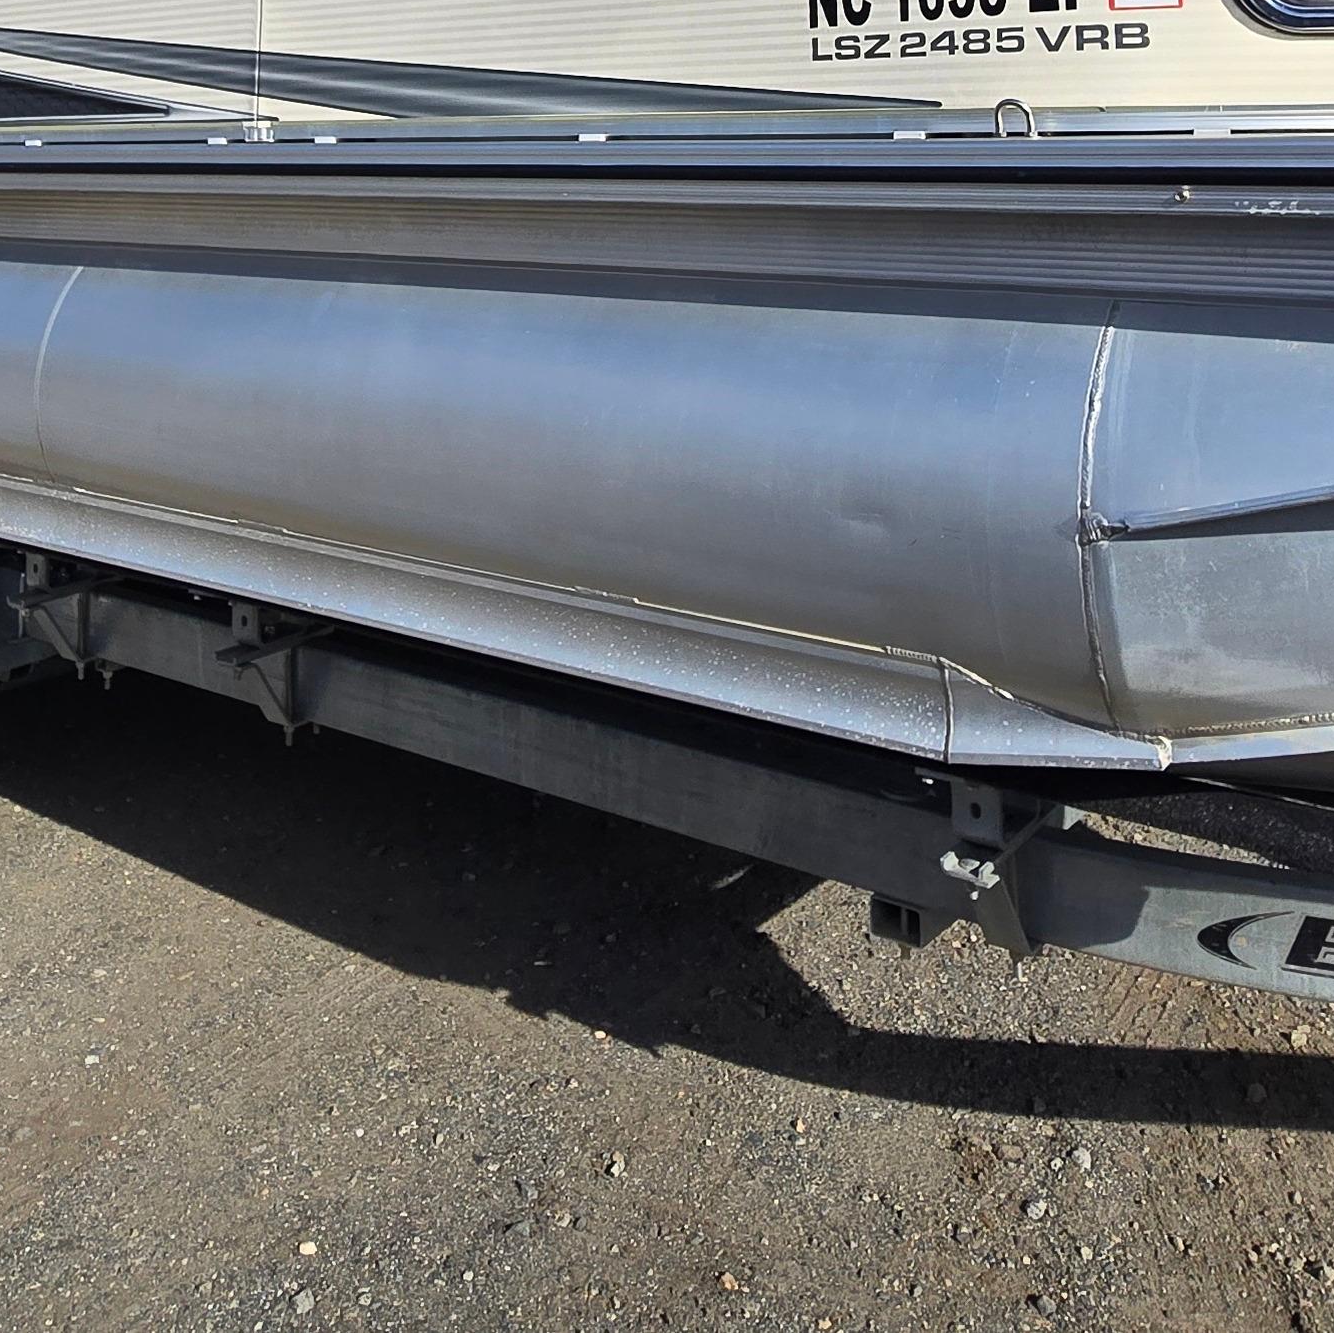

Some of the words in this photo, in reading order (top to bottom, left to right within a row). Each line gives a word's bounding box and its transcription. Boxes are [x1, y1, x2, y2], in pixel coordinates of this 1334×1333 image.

[811, 33, 892, 62] LSZ
[899, 26, 1026, 58] 2485
[1035, 22, 1151, 53] VRB
